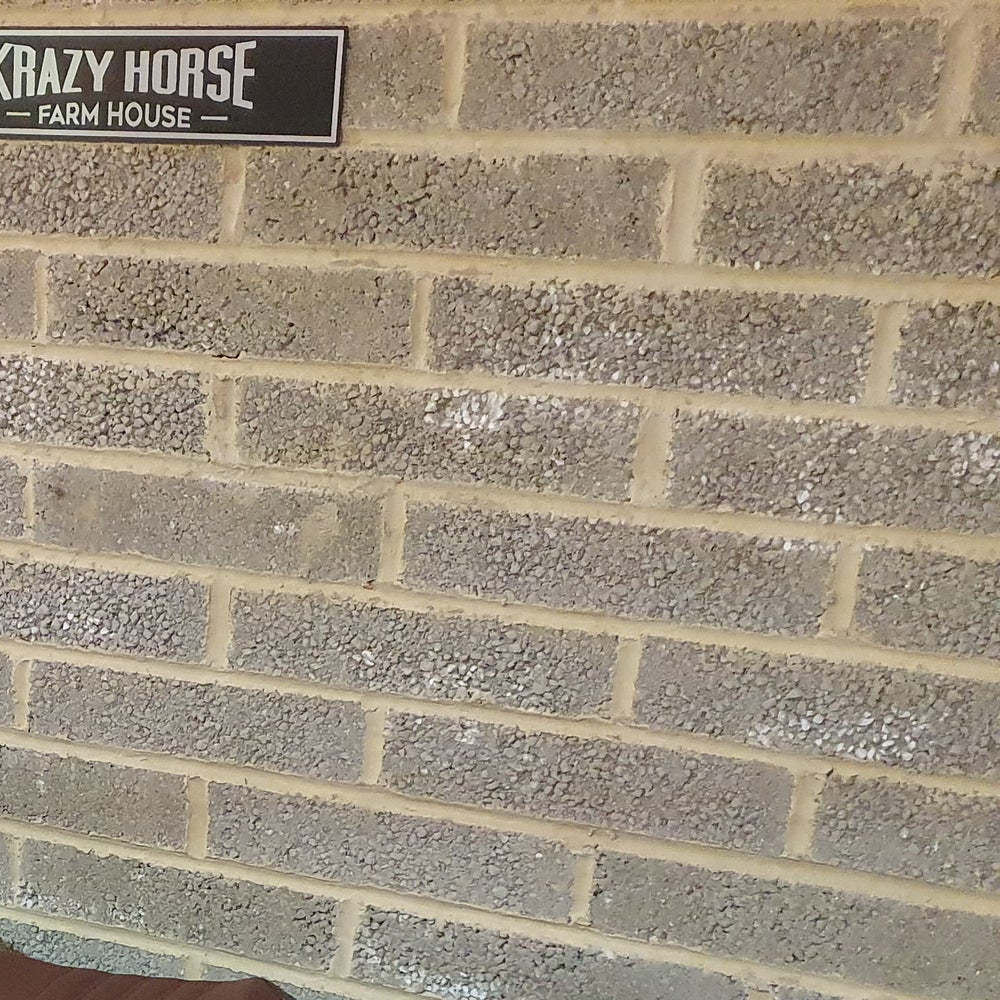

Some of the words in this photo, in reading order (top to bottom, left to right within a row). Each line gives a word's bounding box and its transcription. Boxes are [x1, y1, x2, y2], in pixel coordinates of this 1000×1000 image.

[124, 40, 257, 110] HORSE
[38, 101, 100, 126] FARM
[107, 101, 192, 128] HOUSE
